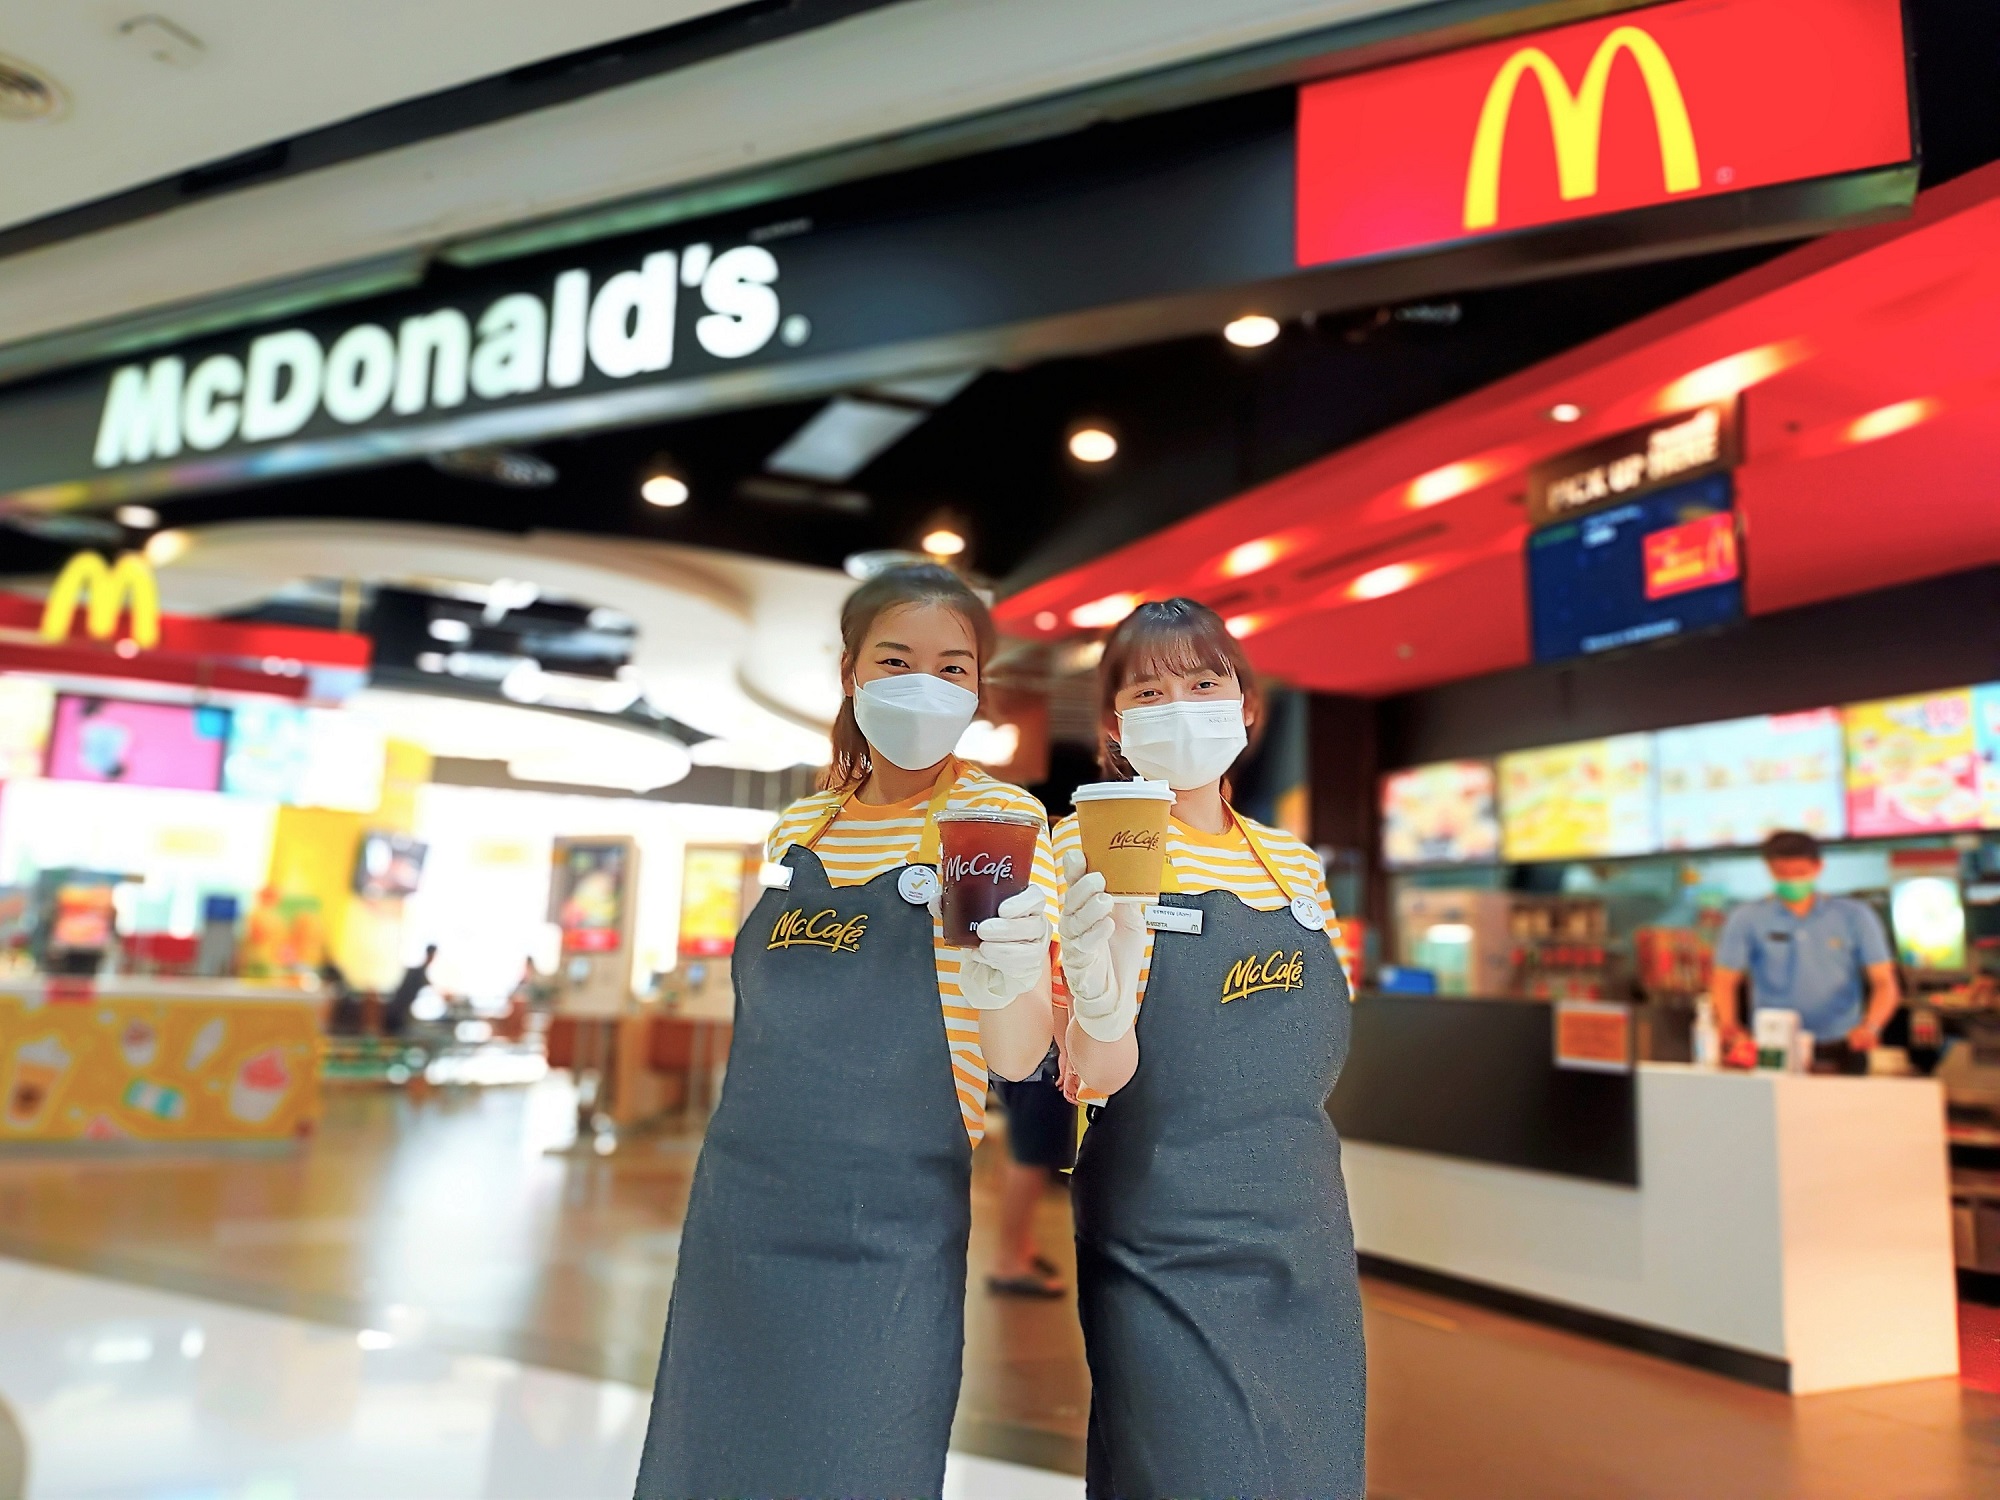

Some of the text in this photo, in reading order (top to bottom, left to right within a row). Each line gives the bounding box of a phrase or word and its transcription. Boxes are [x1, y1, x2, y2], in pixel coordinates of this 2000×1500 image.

[94, 244, 781, 468] McDonald's
[1109, 829, 1160, 851] McCafé
[945, 852, 1013, 885] McCafé
[767, 908, 869, 953] McCafé
[1221, 950, 1304, 1004] McCafé
